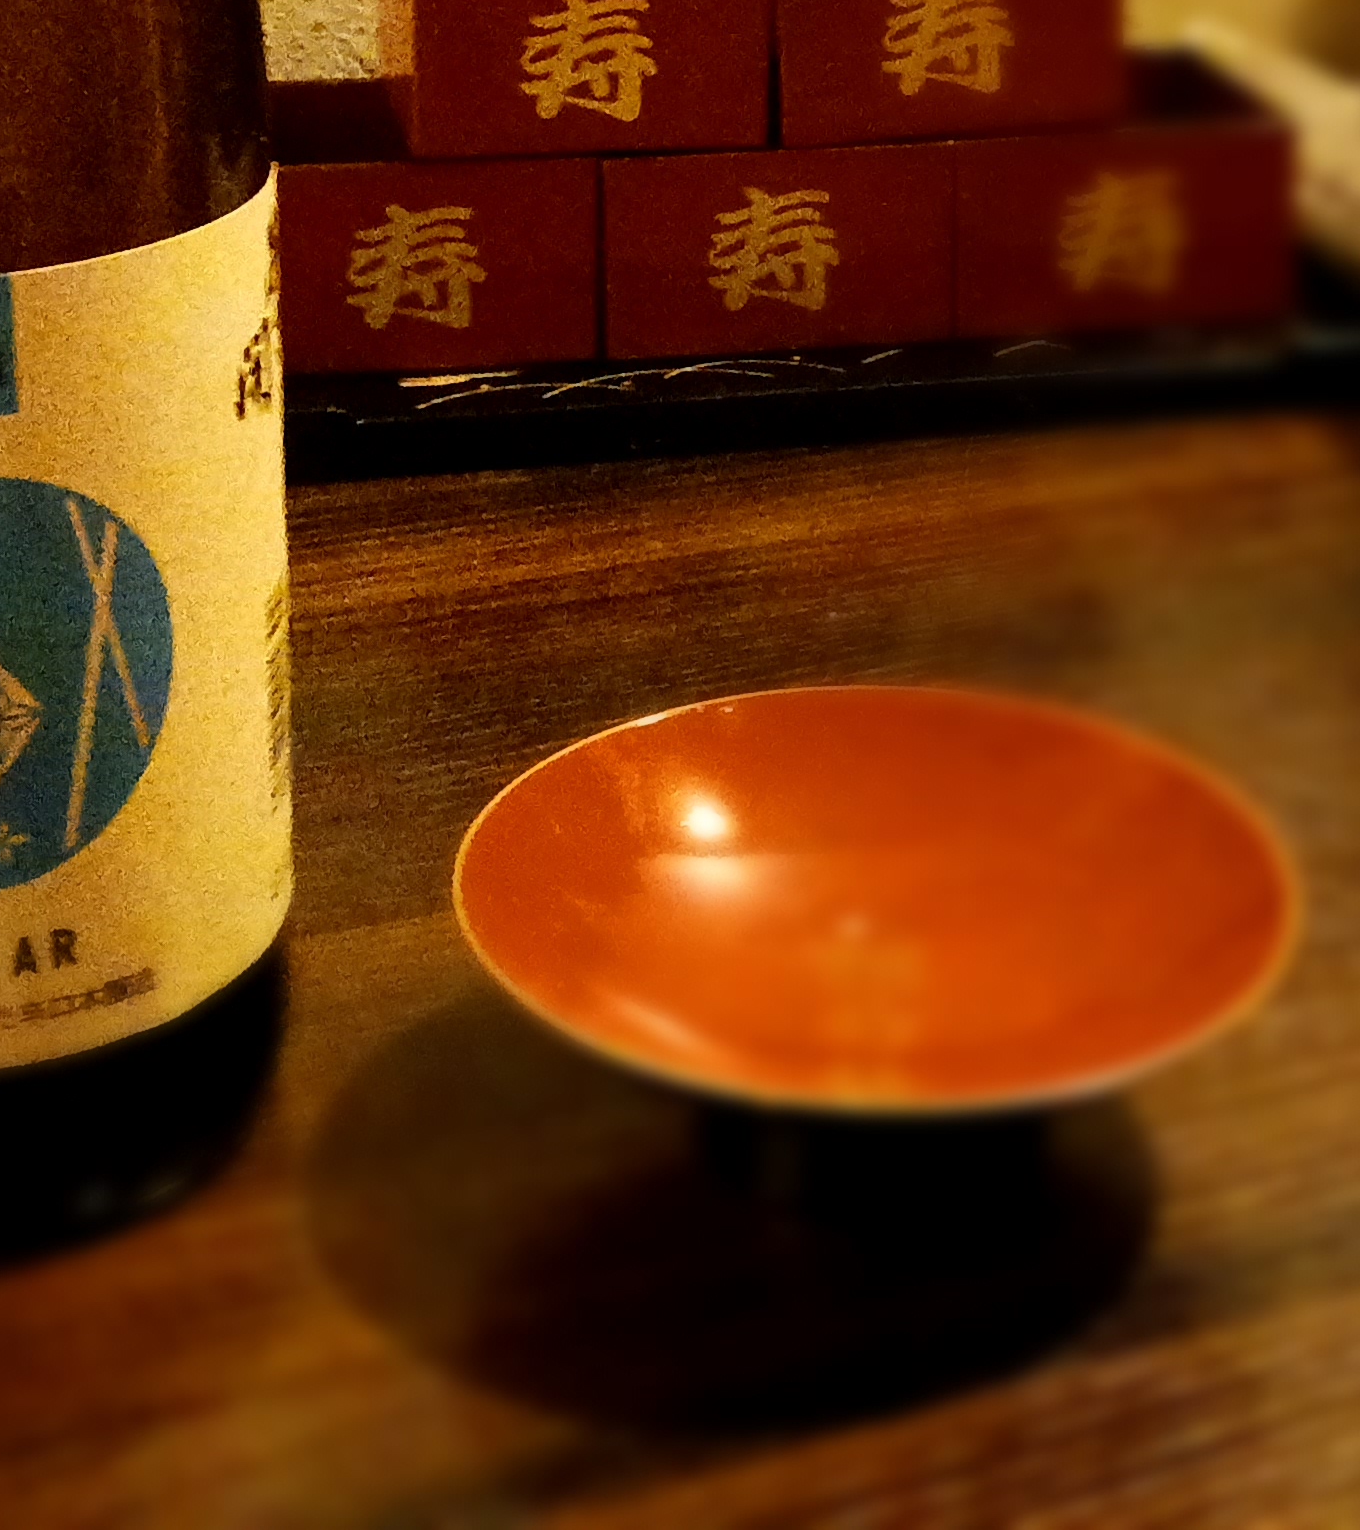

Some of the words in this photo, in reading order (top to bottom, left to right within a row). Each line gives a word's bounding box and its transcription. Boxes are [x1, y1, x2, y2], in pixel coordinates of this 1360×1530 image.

[346, 204, 487, 329] 寿
[707, 187, 840, 311] 寿
[1058, 172, 1183, 292] 寿
